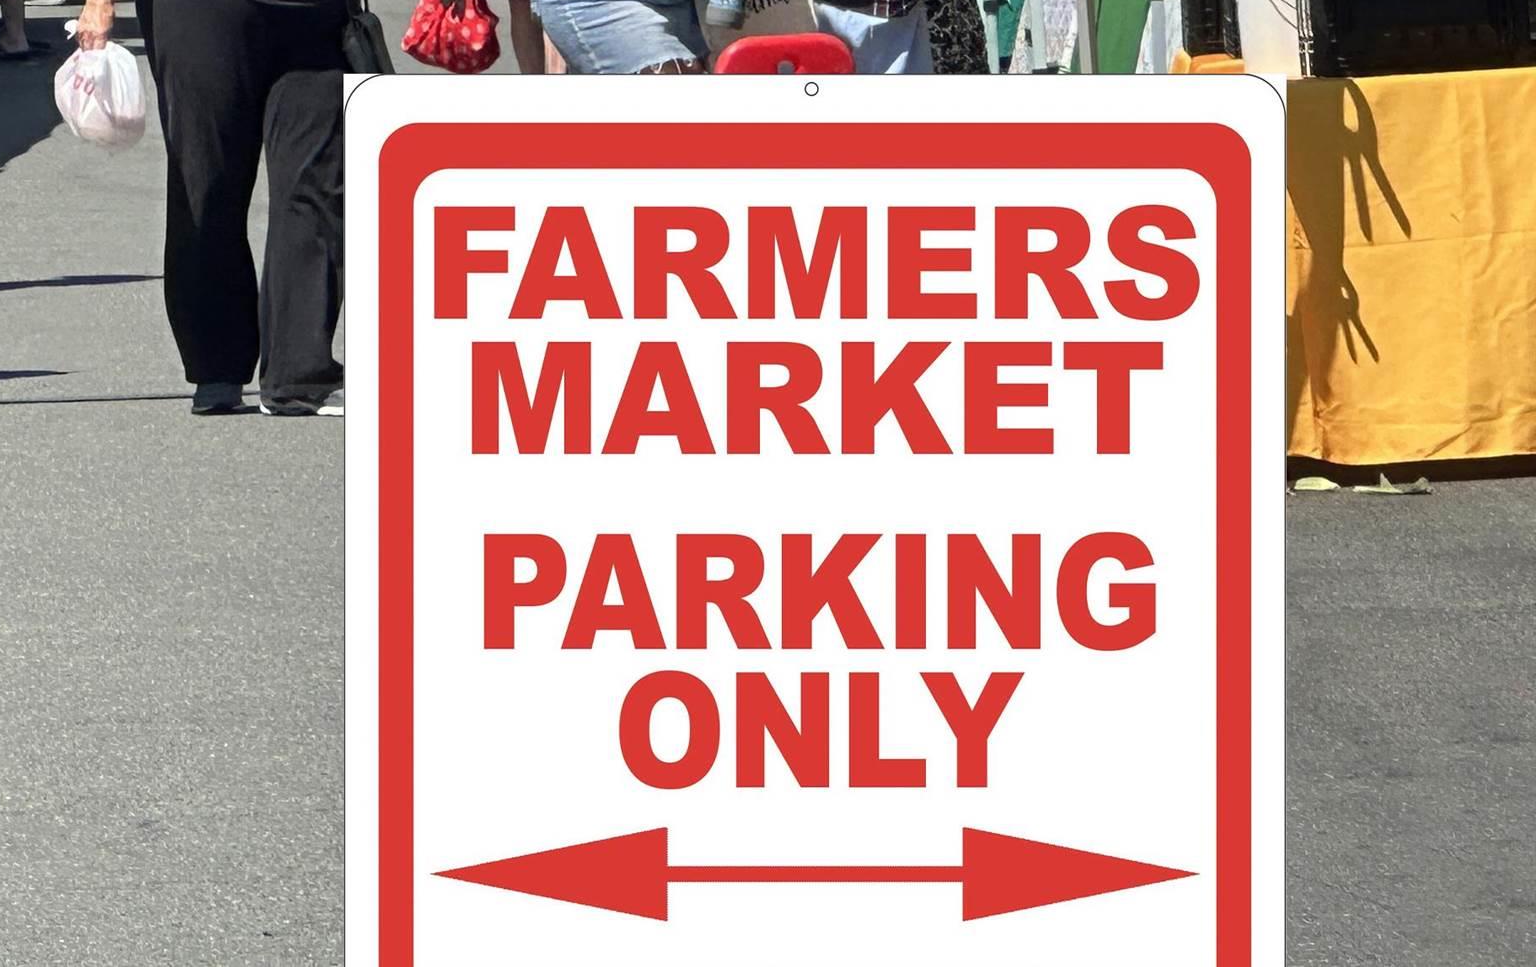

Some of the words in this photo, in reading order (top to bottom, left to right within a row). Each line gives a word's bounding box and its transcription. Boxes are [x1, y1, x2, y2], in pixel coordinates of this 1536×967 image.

[432, 204, 1201, 321] FARMERS
[471, 341, 1164, 455] MARKET
[483, 531, 1158, 651] PARKING
[618, 670, 1026, 790] ONLY
